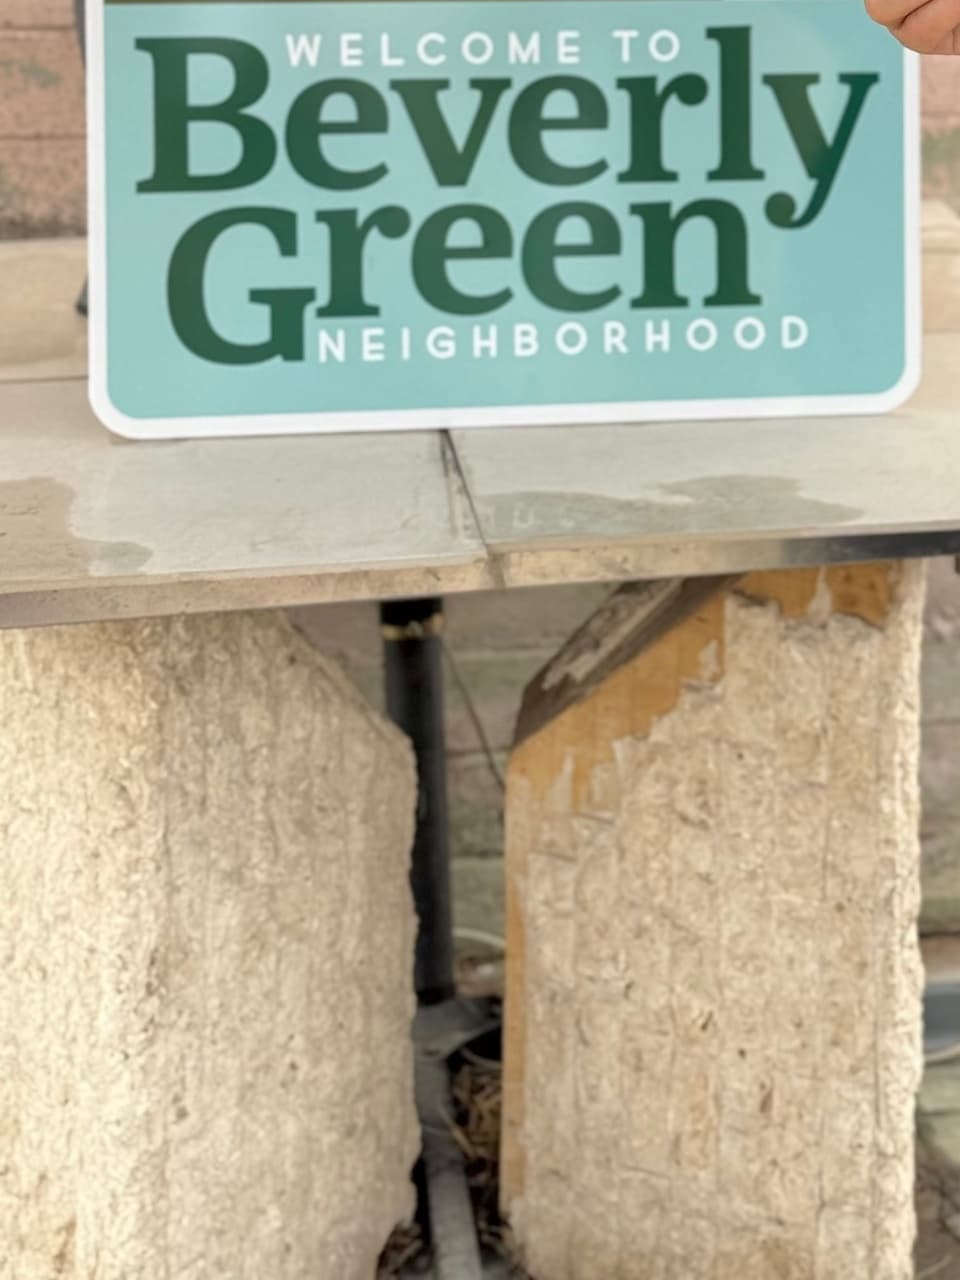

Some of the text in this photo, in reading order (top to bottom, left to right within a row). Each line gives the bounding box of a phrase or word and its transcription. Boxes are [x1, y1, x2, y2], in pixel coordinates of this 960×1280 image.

[284, 28, 682, 68] WELCOME TO
[133, 24, 881, 230] Beverly
[166, 196, 762, 367] Green
[317, 316, 810, 364] NEIGHBORHOOD
